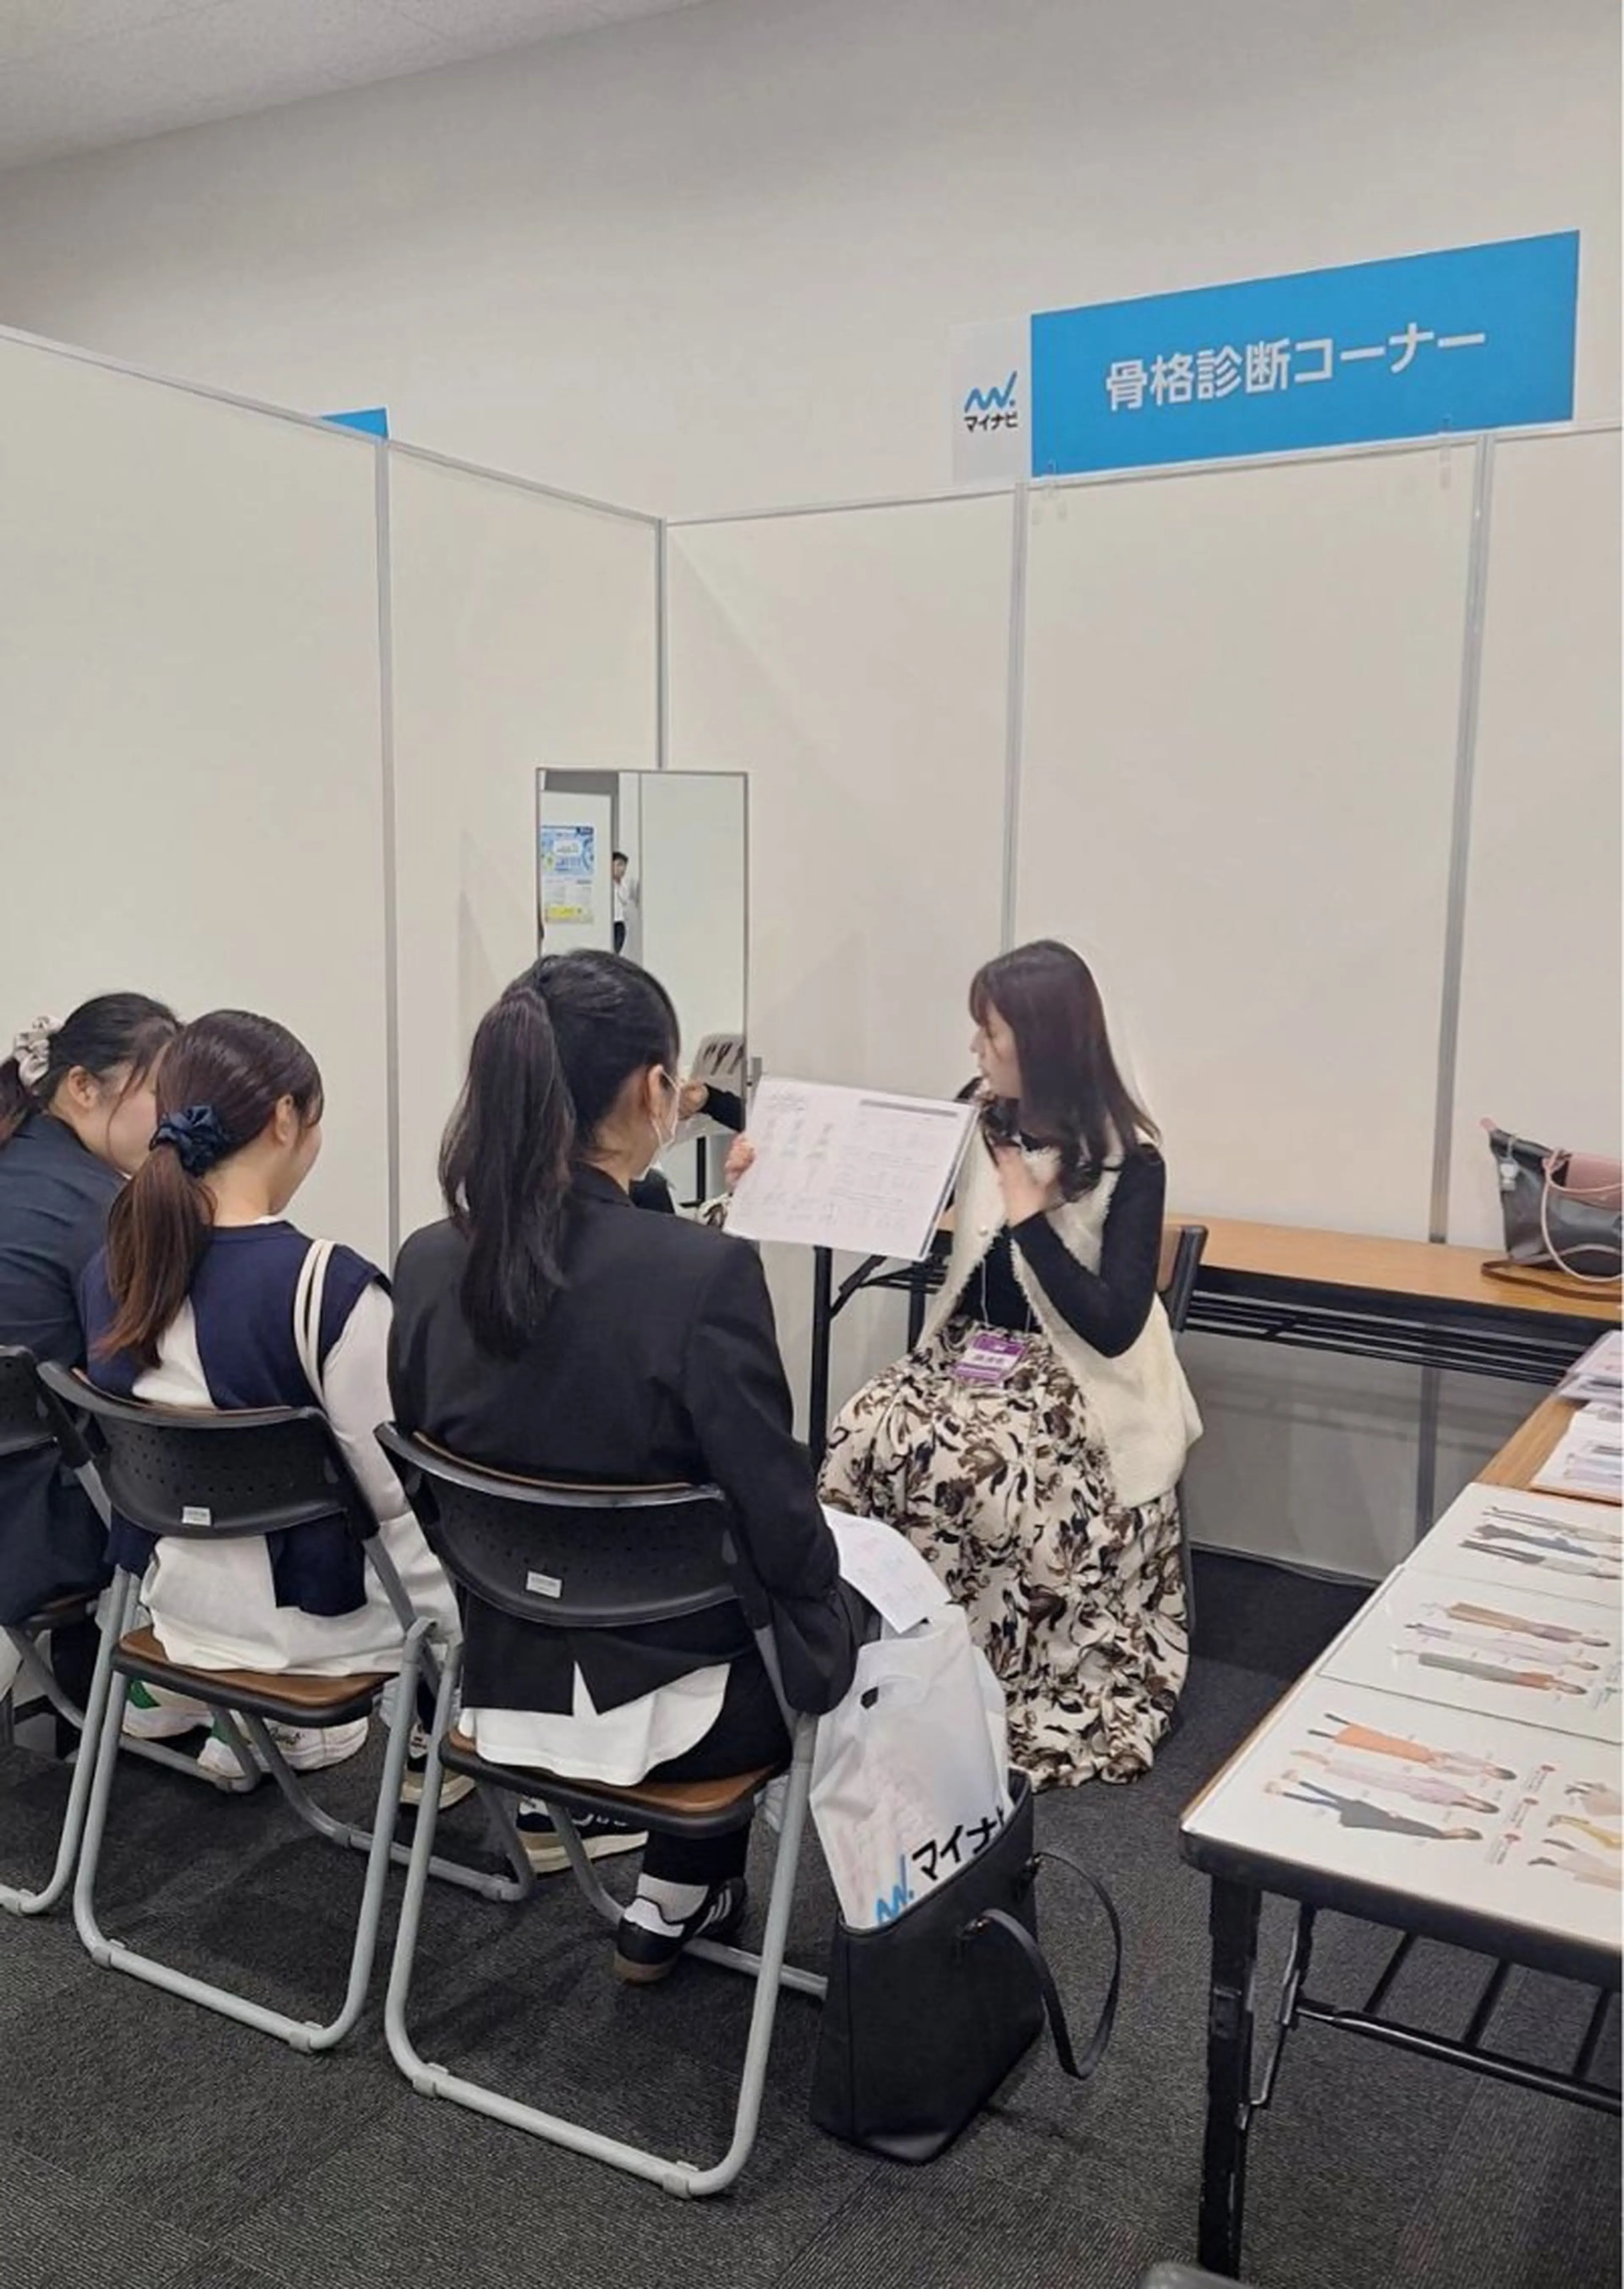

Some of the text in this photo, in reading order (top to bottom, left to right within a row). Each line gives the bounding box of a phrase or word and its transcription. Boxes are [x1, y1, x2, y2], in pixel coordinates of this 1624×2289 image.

[1106, 322, 1486, 412] 骨格診断コーナー
[964, 411, 1018, 432] マイナビ
